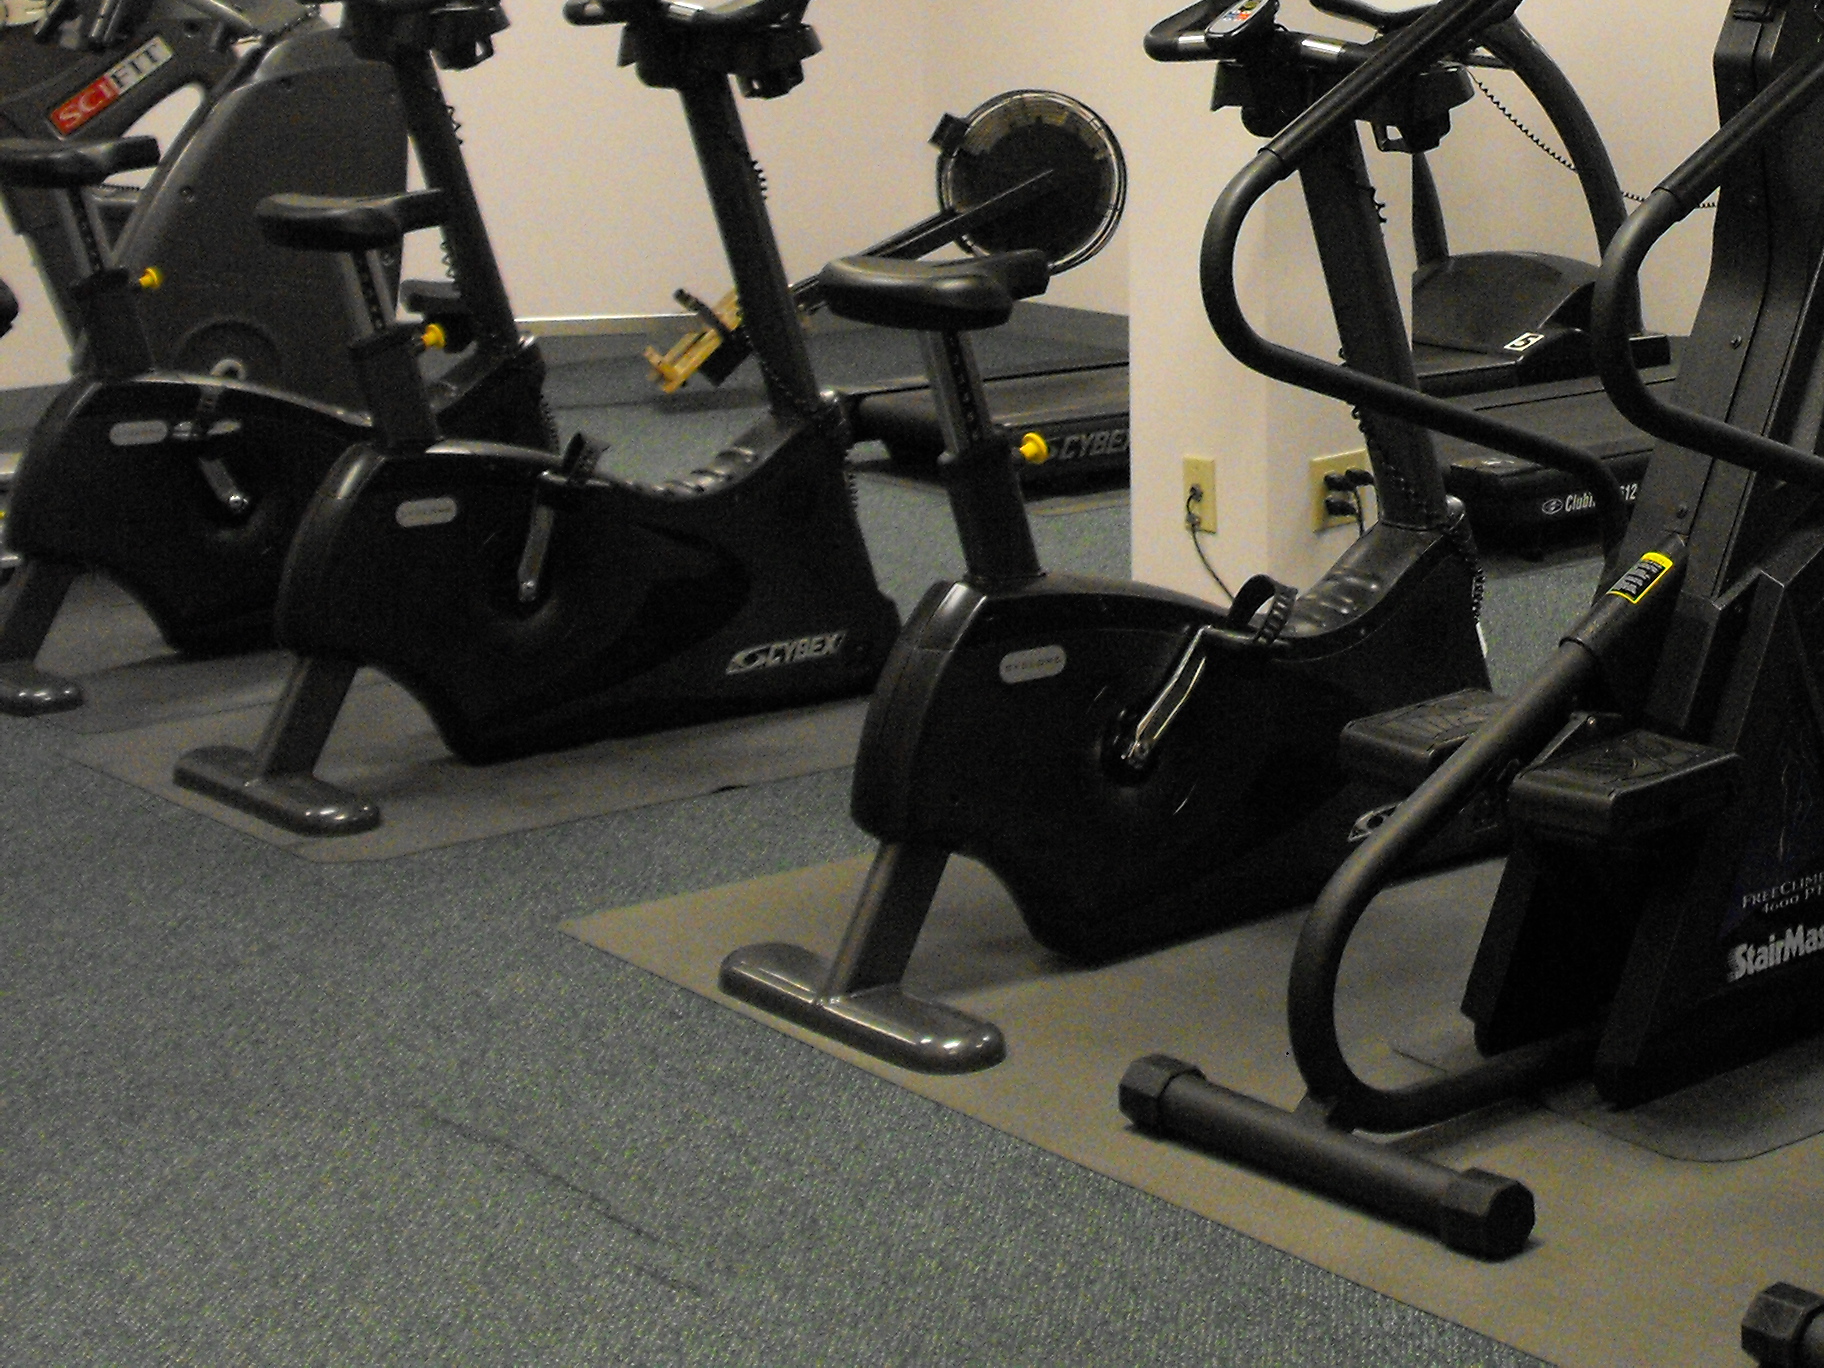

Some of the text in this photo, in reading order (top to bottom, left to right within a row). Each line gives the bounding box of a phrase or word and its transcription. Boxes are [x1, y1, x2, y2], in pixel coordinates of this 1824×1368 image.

[58, 40, 163, 128] SCIFIT
[1513, 334, 1535, 350] 5
[766, 632, 842, 668] CYBEX
